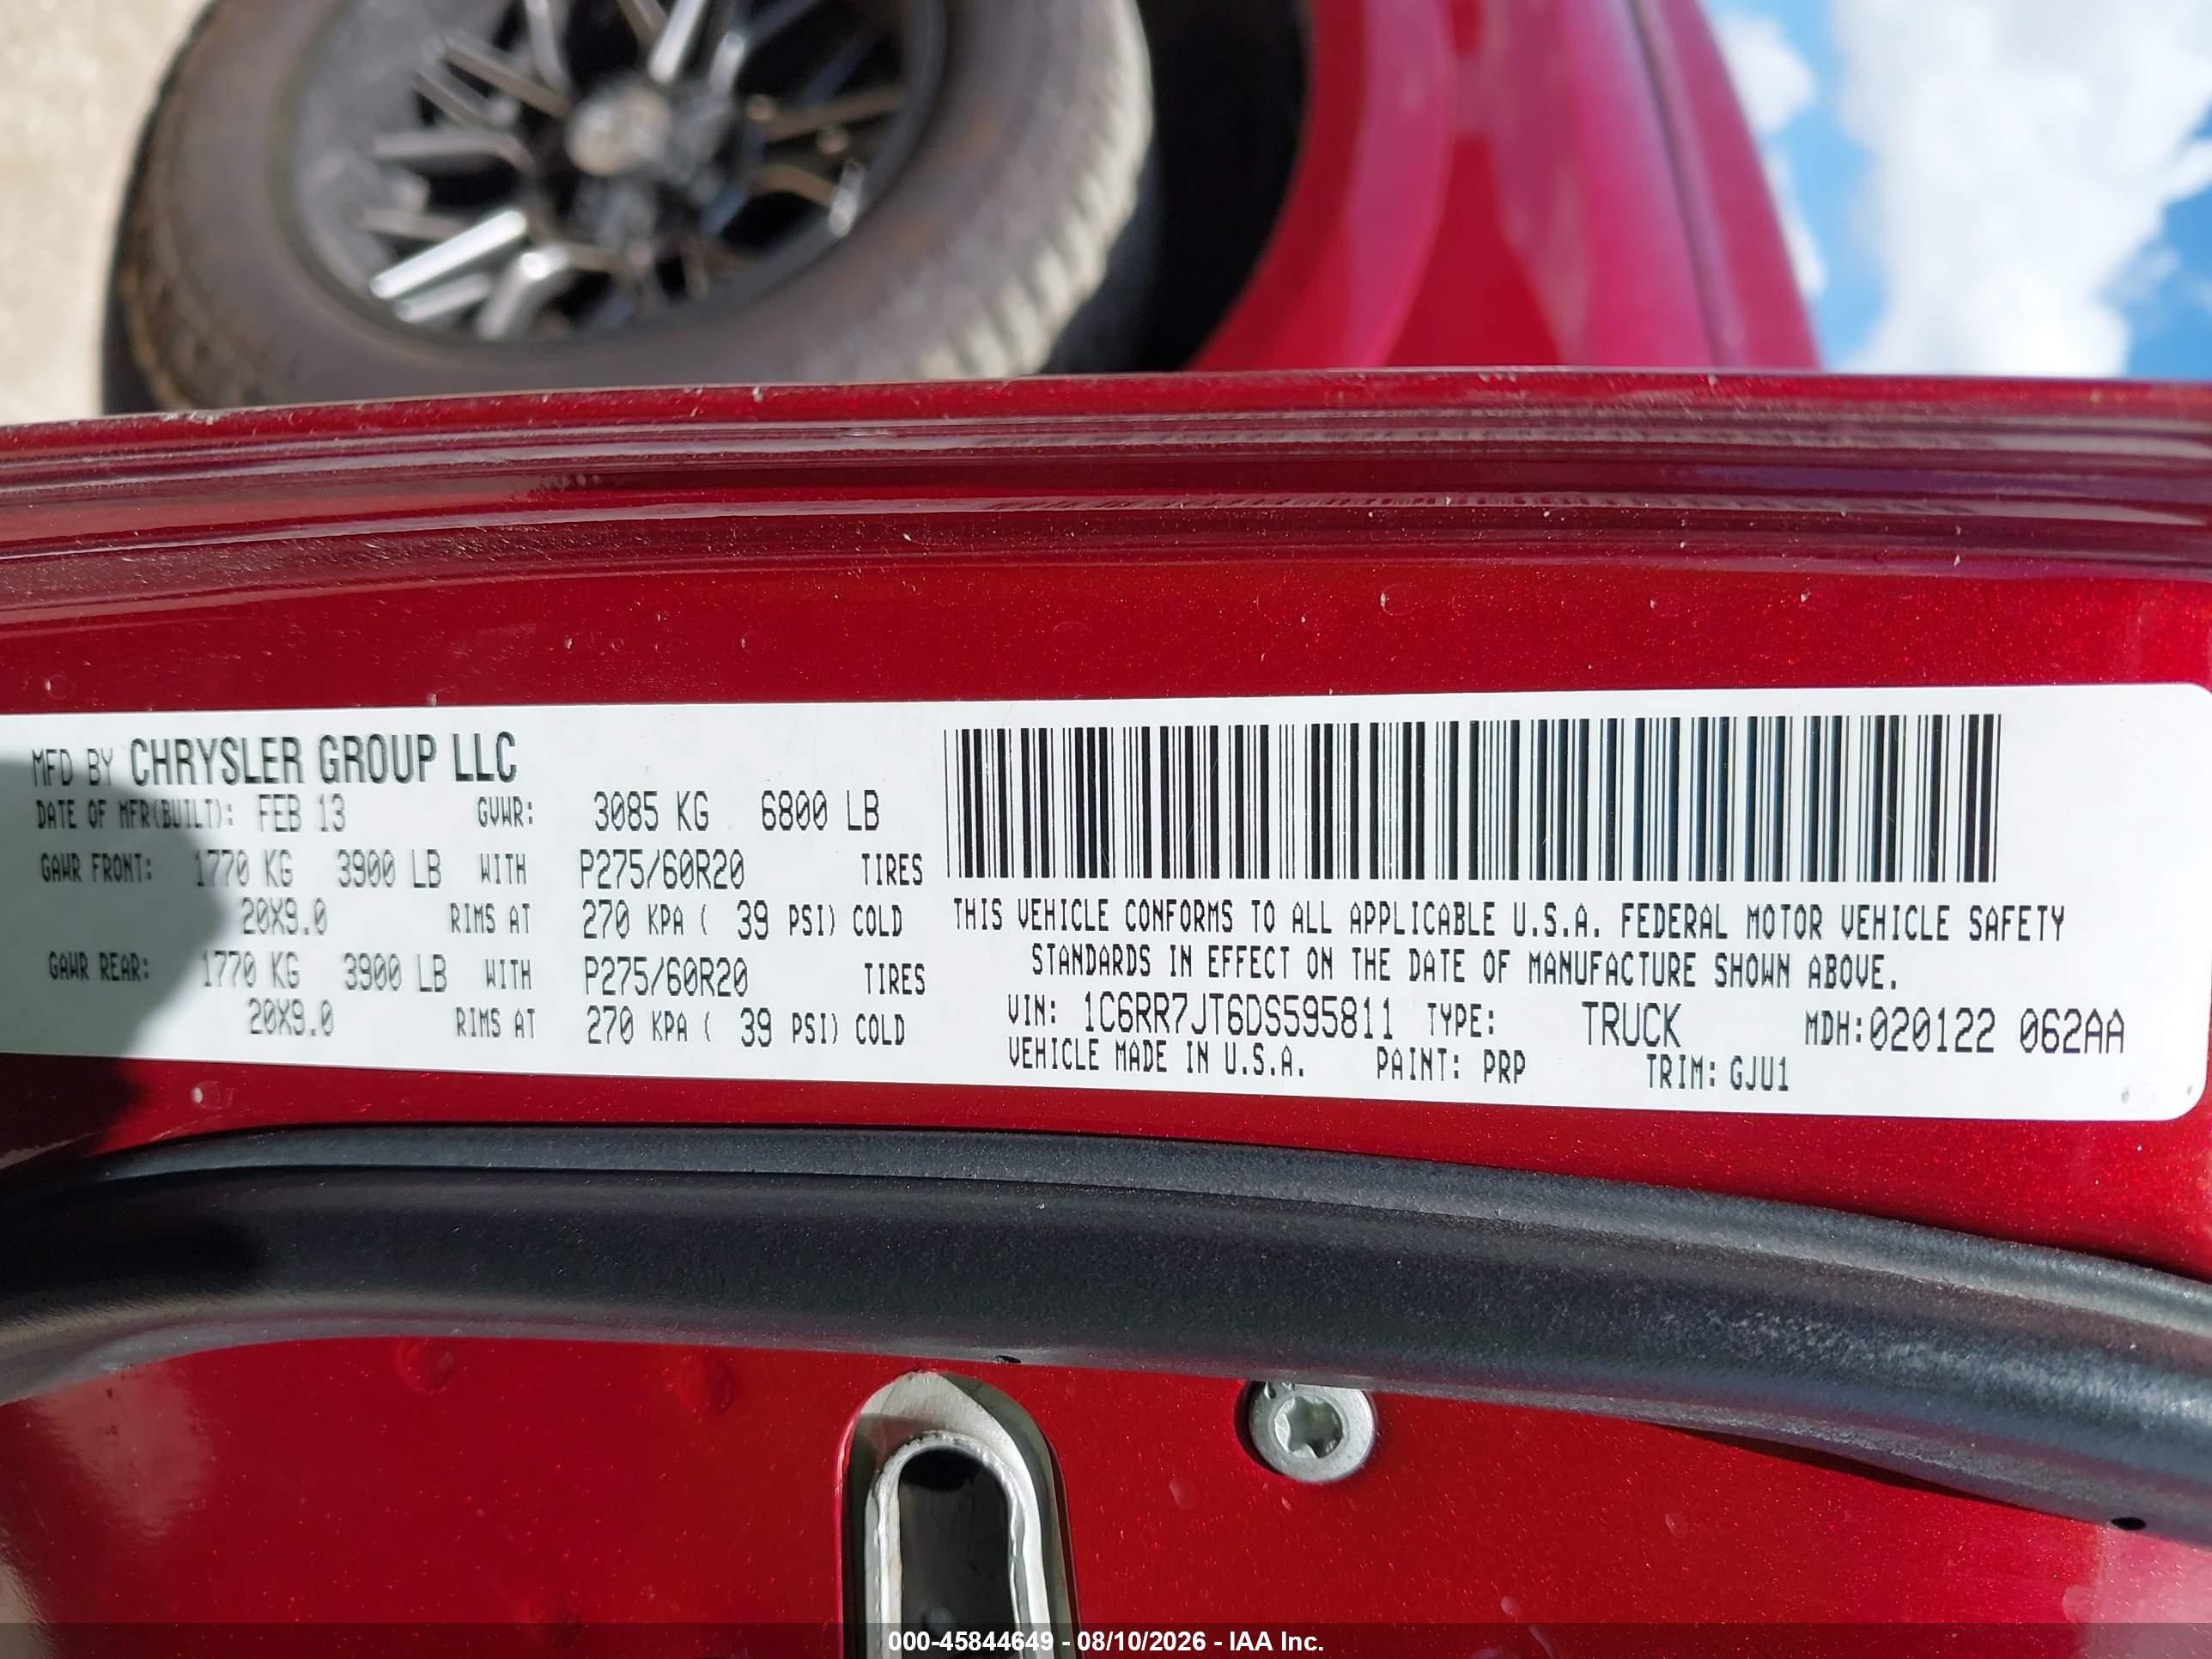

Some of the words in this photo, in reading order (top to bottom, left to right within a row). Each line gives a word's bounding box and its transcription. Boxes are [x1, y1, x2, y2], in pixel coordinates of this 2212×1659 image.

[32, 749, 72, 786] MFD
[87, 749, 112, 786] BY
[131, 737, 304, 787] CHRYSLER
[319, 734, 436, 784] GROUP
[453, 732, 517, 783] LLC
[36, 799, 77, 829] DATE
[88, 799, 106, 829] OF
[118, 799, 234, 829] MFR(BUILT):
[258, 794, 301, 832] FEB
[317, 793, 345, 831] 13
[477, 796, 532, 827] GVWR:
[594, 791, 659, 831] 3085
[678, 791, 708, 831] KG
[762, 790, 827, 830] 6800
[847, 790, 879, 830] LB
[41, 853, 82, 882] GAWR
[91, 853, 152, 882] FRONT:
[196, 849, 249, 887] 1770
[264, 849, 293, 887] KG
[337, 849, 395, 888] 3900
[412, 849, 441, 888] LB
[481, 854, 526, 884] WITH
[580, 849, 744, 890] P275/60R20
[862, 854, 922, 885] TIRES
[242, 897, 327, 935] 20X9.0
[450, 902, 495, 933] RIMS
[509, 903, 530, 933] AT
[583, 899, 629, 939] 270
[648, 904, 684, 935] KPA
[737, 900, 769, 940] 39
[789, 904, 835, 936] PSI)
[854, 905, 902, 937] COLD
[954, 898, 1002, 930] THIS
[1018, 898, 1109, 931] VEHICLE
[1126, 899, 1232, 933] CONFORMS
[1252, 900, 1274, 933] TO
[1292, 901, 1332, 933] ALL
[1351, 901, 1495, 936] APPLICABLE
[1514, 902, 1599, 938] U.S.A.
[1622, 902, 1728, 939] FEDERAL
[1747, 904, 1822, 939] MOTOR
[1841, 904, 1950, 941] VEHICLE
[1969, 905, 2064, 941] SAFETY
[48, 951, 89, 980] GAWR
[99, 952, 149, 981] REAR:
[204, 950, 256, 988] 1770
[271, 951, 299, 988] KG
[343, 952, 401, 991] 3900
[418, 954, 447, 993] LB
[485, 959, 532, 989] WITH
[585, 956, 748, 997] P275/60R20
[865, 963, 925, 995] TIRES
[1032, 943, 1150, 976] STANDARDS
[1170, 945, 1191, 977] IN
[1208, 945, 1289, 979] EFFECT
[1307, 946, 1332, 980] ON
[1352, 947, 1390, 981] THE
[1409, 948, 1465, 982] DATE
[1484, 949, 1510, 983] OF
[1529, 951, 1696, 987] MANUFACTURE
[1715, 952, 1790, 988] SHOWN
[1808, 954, 1896, 989] ABOVE.
[247, 998, 333, 1036] 20X9.0
[456, 1007, 501, 1037] RIMS
[515, 1008, 535, 1038] AT
[587, 1006, 634, 1044] 270
[653, 1011, 687, 1042] KPA
[740, 1007, 772, 1047] 39
[793, 1012, 837, 1044] PSI)
[856, 1013, 904, 1045] COLD
[1008, 994, 1055, 1026] VIN:
[1085, 992, 1393, 1039] 1C6RR7JT6DS595811
[1427, 1003, 1493, 1037] TYPE:
[1582, 1001, 1681, 1048] TRUCK
[2020, 1008, 2124, 1054] 062AA
[1009, 1036, 1099, 1070] VEHICLE
[1115, 1039, 1167, 1073] MADE
[1187, 1041, 1208, 1073] IN
[1225, 1042, 1304, 1077] U.S.A.
[1377, 1046, 1459, 1081] PAINT:
[1484, 1049, 1525, 1084] PRP
[1646, 1054, 1715, 1090] TRIM:
[1730, 1055, 1788, 1091] GJU1
